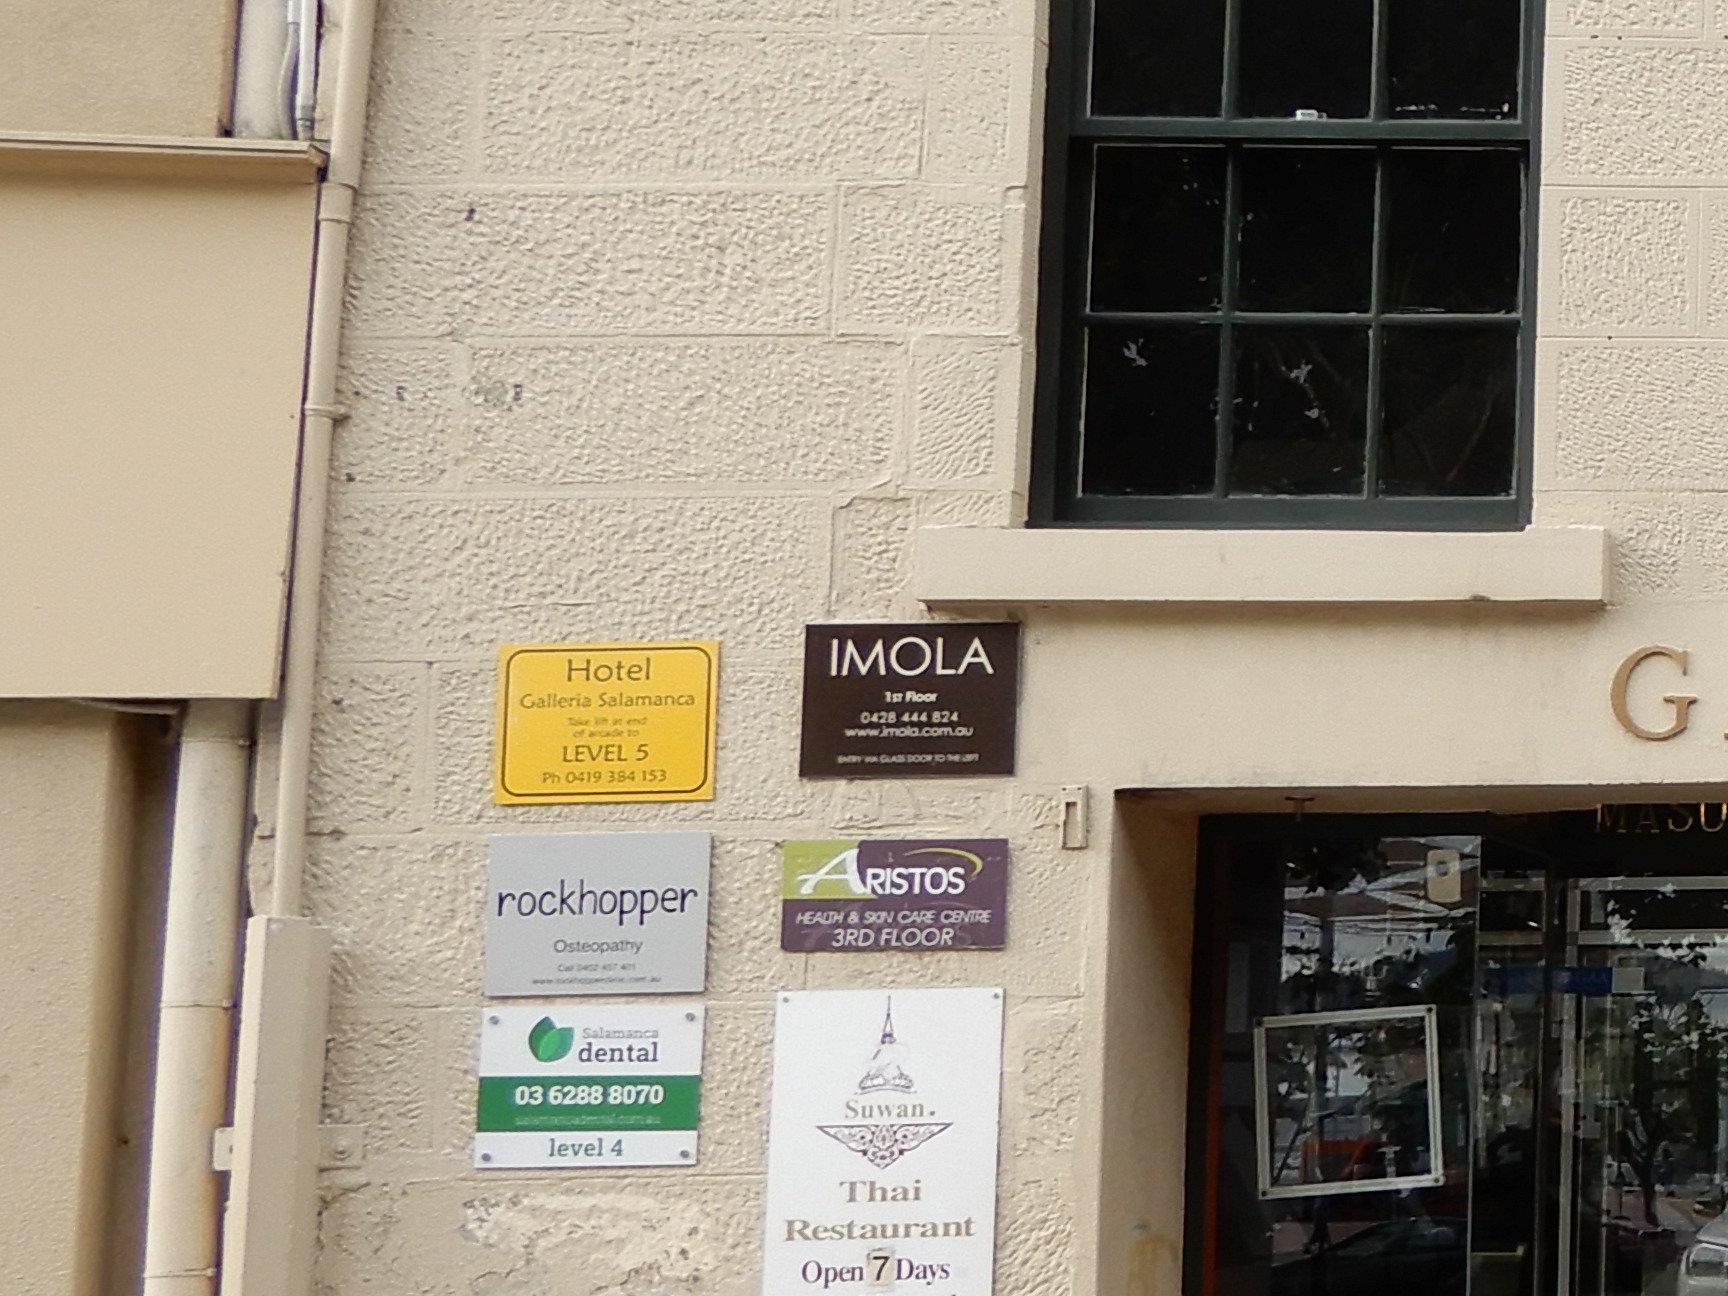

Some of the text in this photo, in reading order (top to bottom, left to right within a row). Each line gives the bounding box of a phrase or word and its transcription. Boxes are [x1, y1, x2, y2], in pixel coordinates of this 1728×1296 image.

[830, 636, 994, 676] IMOLA
[567, 657, 651, 682] Hotel
[520, 692, 695, 709] Galleria Salamanca
[884, 691, 938, 703] 1st Floor
[860, 711, 959, 723] 0428 444 824
[844, 725, 974, 737] www.imola.com.au
[563, 744, 649, 762] LEVEL 5
[542, 771, 560, 783] Ph
[565, 771, 602, 783] 0419
[642, 769, 667, 781] 153
[797, 848, 966, 895] ARISTOS
[497, 879, 698, 926] rockhopper
[796, 910, 991, 924] HEALTH & SKIN CARE CENTRE
[554, 939, 643, 954] Osteopathy
[832, 928, 955, 947] 3RD FLOOR
[582, 1027, 658, 1039] Salamanca
[578, 1042, 658, 1062] dental
[515, 1085, 664, 1105] 03 6288 8070
[549, 1138, 623, 1157] level 4
[839, 1179, 922, 1203] Thai
[785, 1217, 976, 1242] Restaurant
[801, 1255, 950, 1288] Open 7 Days
